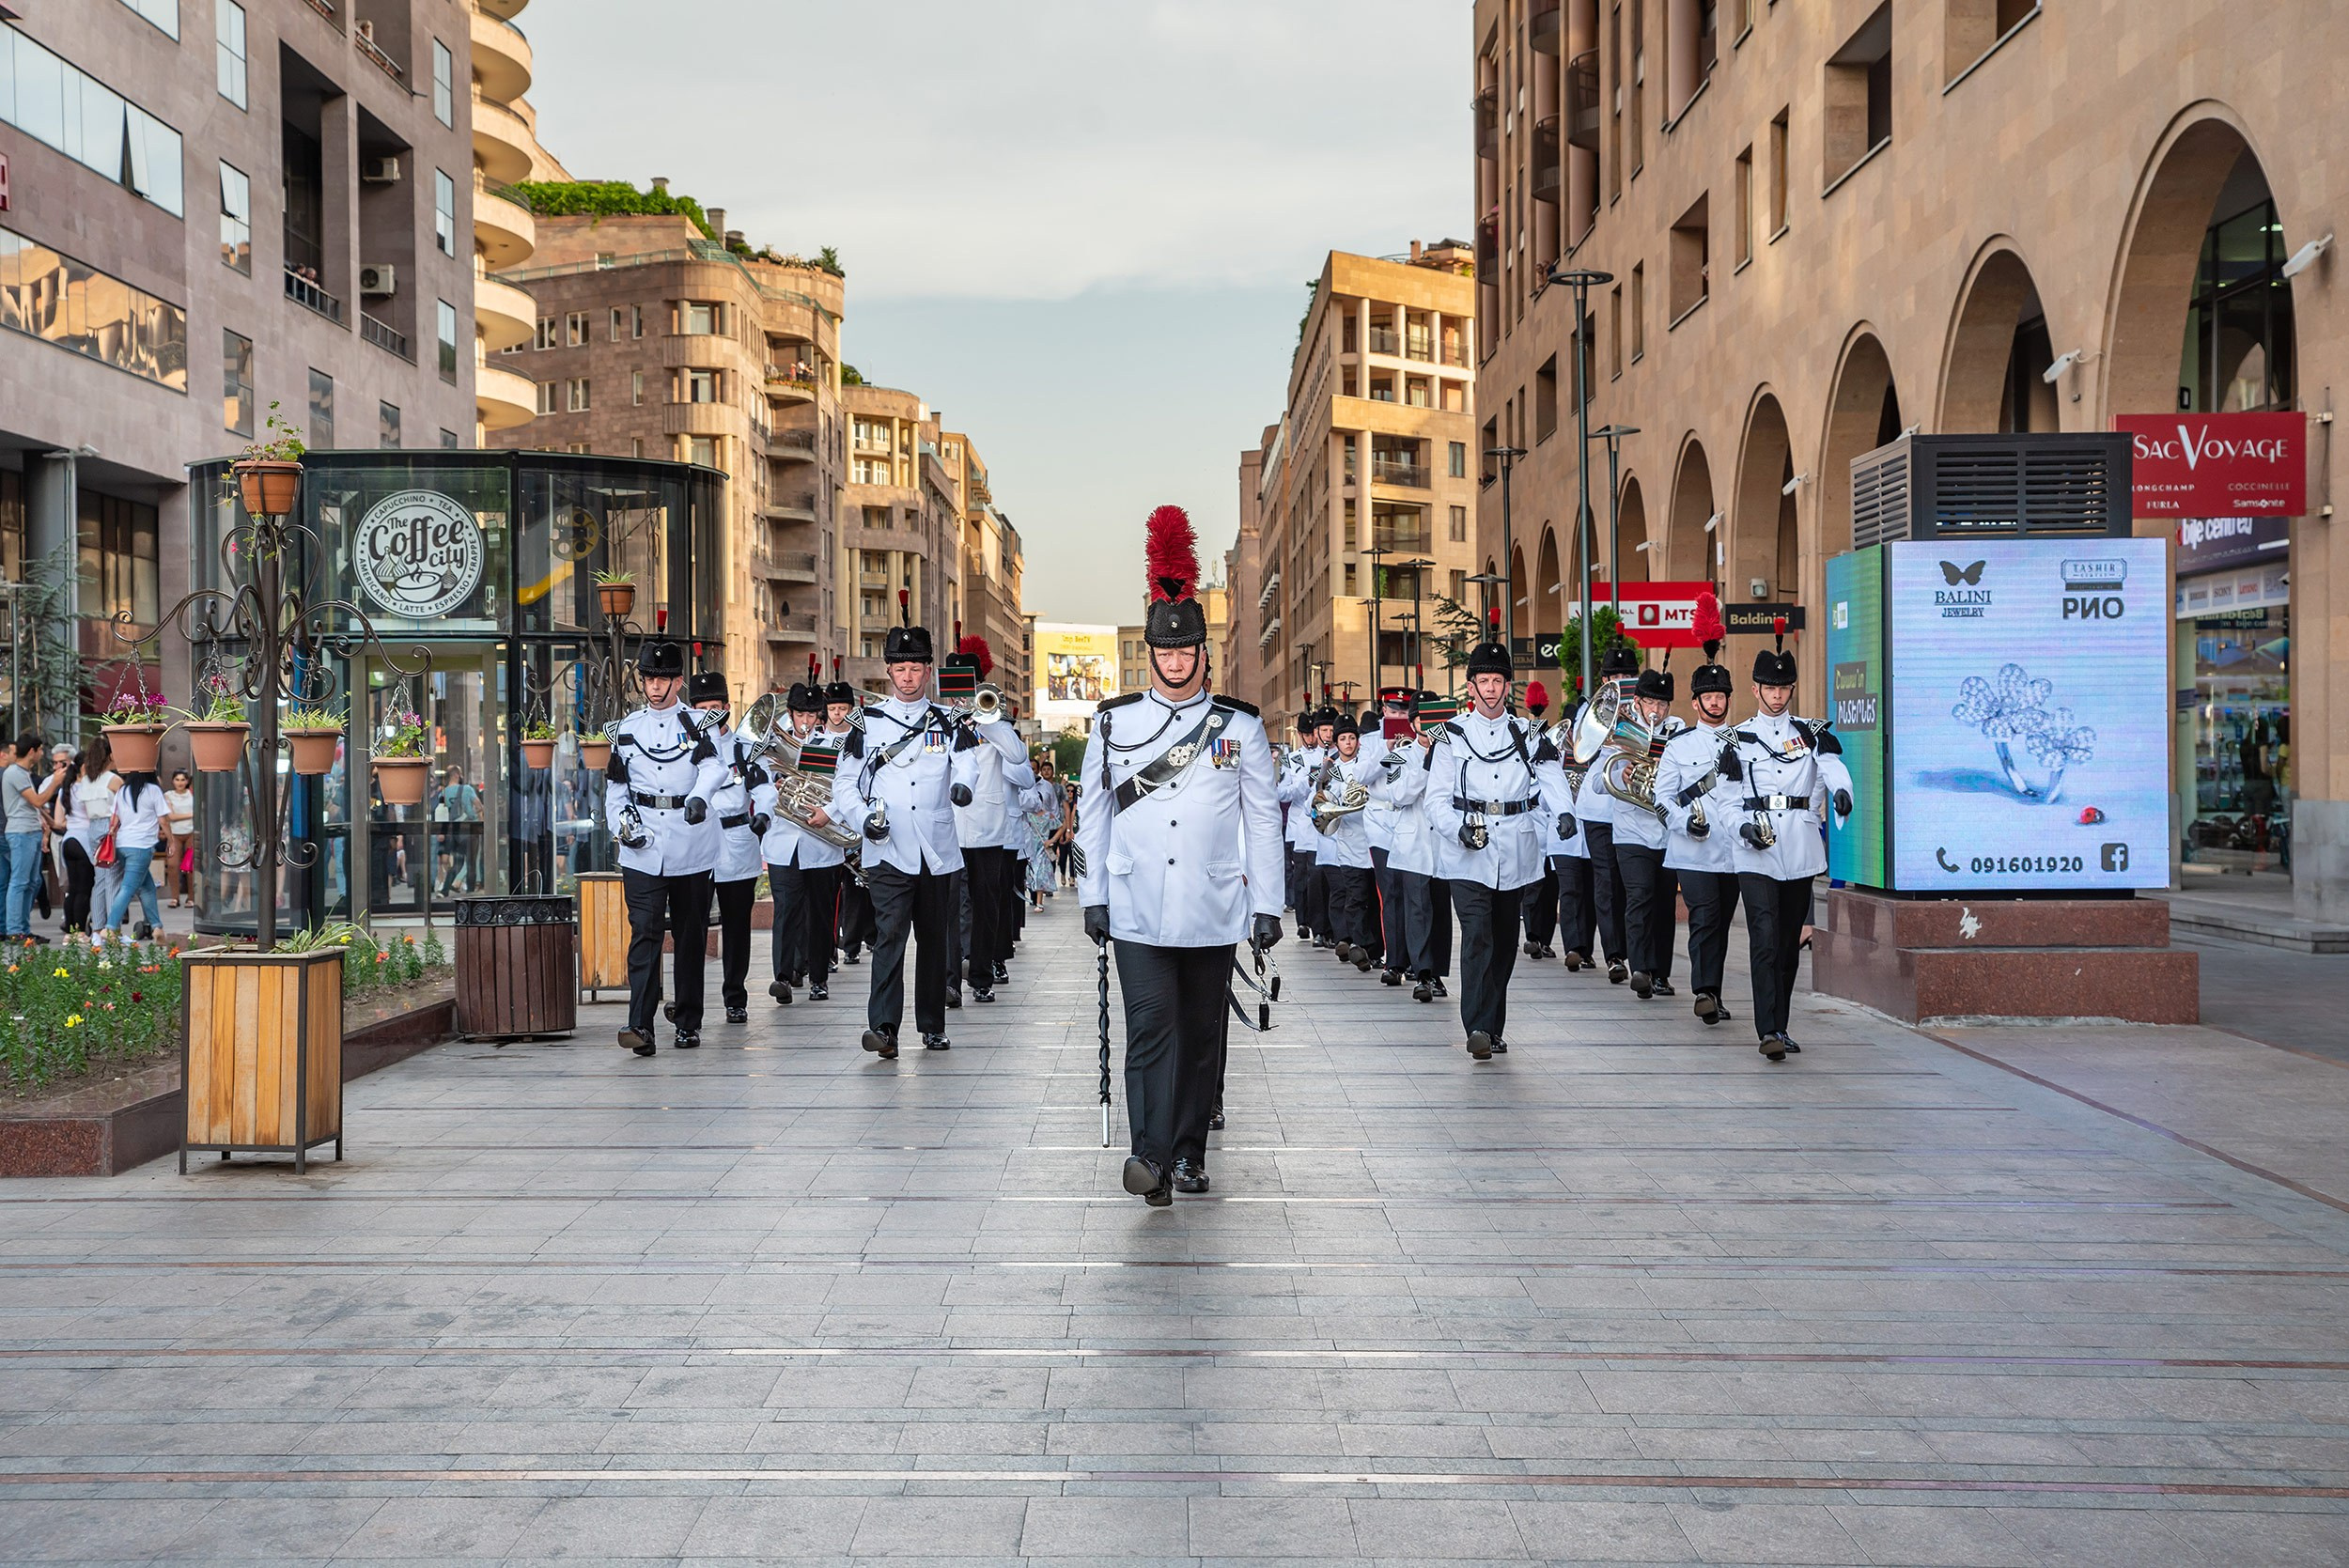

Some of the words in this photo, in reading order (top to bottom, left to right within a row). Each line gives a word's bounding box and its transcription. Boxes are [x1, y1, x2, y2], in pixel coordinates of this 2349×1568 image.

[374, 495, 426, 519] CAPUCCHINO
[439, 500, 452, 512] TEA
[387, 517, 408, 529] The
[368, 515, 464, 565] Coffee
[429, 546, 464, 568] city
[470, 538, 478, 572] FRAPPE
[359, 558, 391, 604] AMERICANO
[434, 581, 470, 610] ESPRESSO
[1936, 590, 1992, 603] BALINI
[398, 603, 425, 613] LATTE
[1942, 607, 1984, 617] JEWELRY
[1730, 613, 1789, 625] Baldinii
[1970, 856, 2083, 873] 091601920
